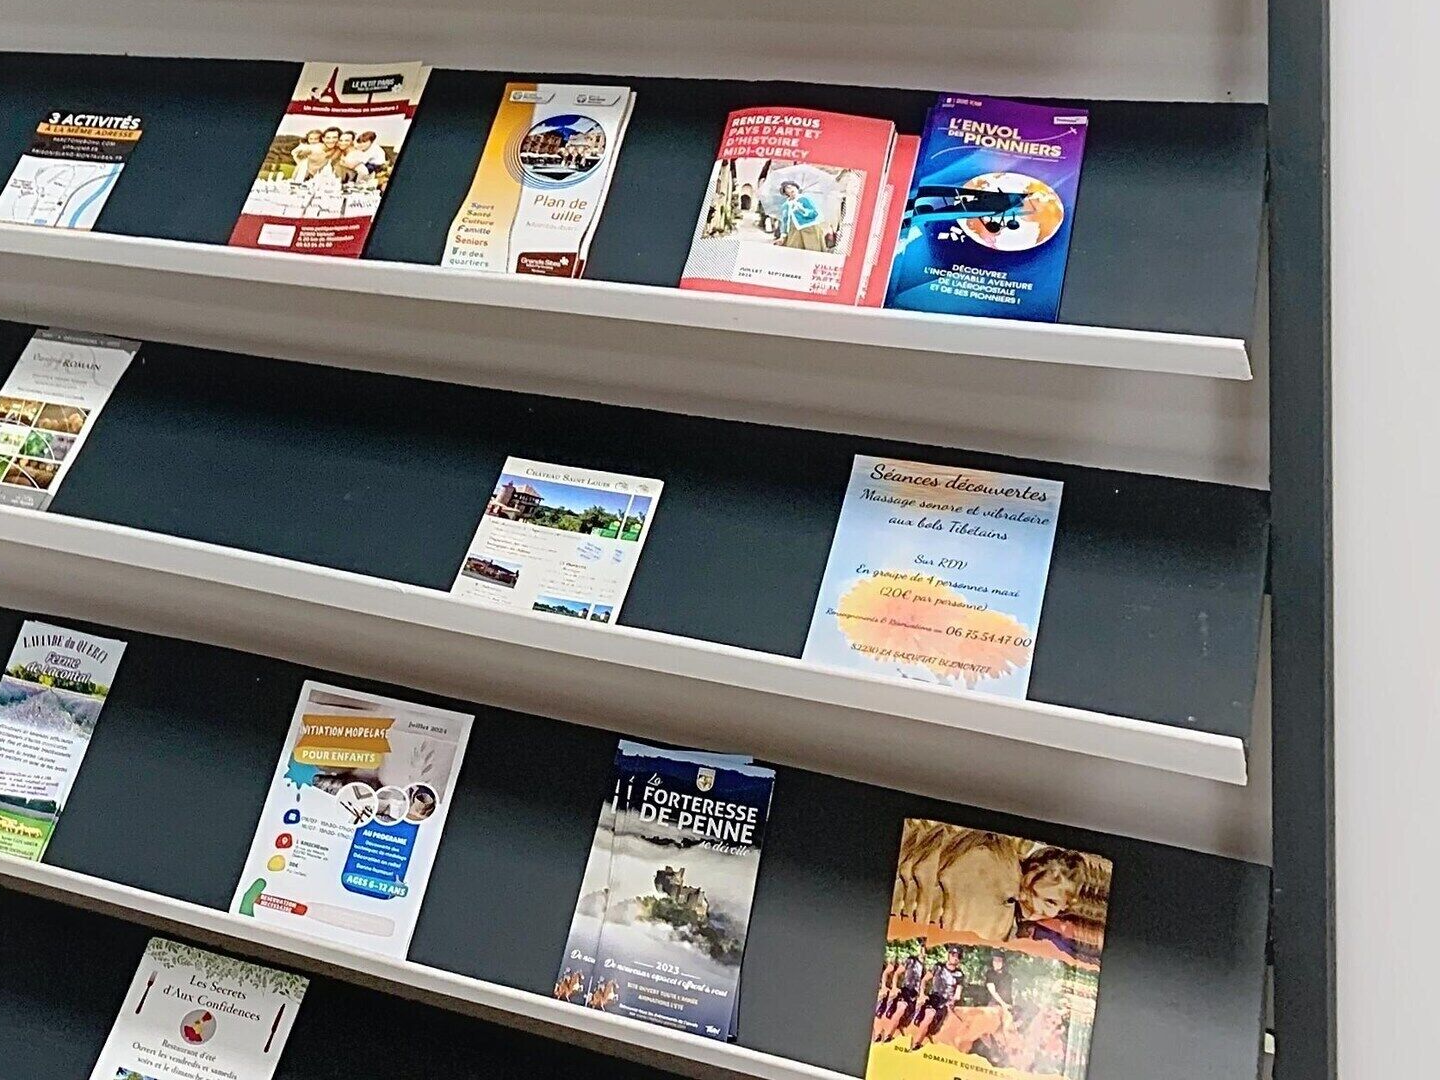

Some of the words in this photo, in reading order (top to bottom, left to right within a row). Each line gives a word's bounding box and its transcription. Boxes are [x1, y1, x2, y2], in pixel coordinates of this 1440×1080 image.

[351, 80, 359, 88] LE
[49, 112, 61, 124] 3
[63, 114, 141, 130] ACTIVITÉS
[732, 115, 821, 128] RENDEZ-VOUS
[94, 130, 134, 138] ADRESSE
[729, 126, 760, 136] PAYS
[763, 126, 801, 138] D'ART
[805, 130, 822, 139] ET
[949, 118, 1021, 140] L'ENVOL
[726, 135, 800, 147] D'HISTOIRE
[964, 132, 1063, 157] PIONNIERS
[723, 146, 810, 159] MIDI-QUERCY
[471, 202, 495, 210] Sport
[534, 195, 564, 208] Plan
[569, 195, 588, 210] de
[467, 209, 491, 218] Santé
[462, 217, 495, 226] Culture
[457, 225, 491, 235] Famille
[455, 235, 489, 247] Seniors
[469, 249, 484, 258] des
[449, 258, 489, 268] quartiers
[924, 266, 986, 284] L'INCROYABLE
[988, 278, 1033, 291] AVENTURE
[952, 264, 1008, 279] DÉCOUVREZ
[971, 291, 1016, 304] PIONNIERS
[870, 463, 940, 487] Séances
[945, 474, 1048, 502] découvertes
[859, 489, 916, 508] Massage
[919, 500, 962, 515] sonore
[966, 505, 980, 516] et
[983, 505, 1050, 526] vibratoire
[888, 516, 912, 527] aux
[917, 517, 943, 531] bols
[914, 554, 934, 566] Sur
[938, 557, 968, 570] RDV
[856, 563, 870, 575] En
[873, 569, 907, 583] groupe
[909, 570, 924, 582] de
[935, 577, 988, 594] personnes
[991, 587, 1020, 599] maxi
[912, 592, 931, 604] par
[934, 595, 988, 612] personne)
[45, 651, 81, 668] Ferme
[302, 750, 329, 762] POUR
[331, 751, 375, 762] ENFANTS
[643, 786, 759, 823] FORTERESSE
[639, 803, 672, 827] DE
[678, 810, 755, 844] PENNE
[711, 840, 751, 856] dévoile
[346, 875, 366, 888] AGES
[387, 884, 407, 896] ANS
[656, 961, 680, 974] 2023
[190, 975, 207, 989] Les
[210, 982, 247, 1000] Secrets
[163, 985, 194, 1003] d'Aux
[197, 995, 261, 1021] Confidences
[162, 1039, 199, 1055] Restaurant
[199, 1049, 216, 1062] d'été
[132, 1042, 156, 1056] Ouvert
[169, 1054, 201, 1069] vendredis
[210, 1068, 238, 1080] samedis
[137, 1056, 152, 1066] soirs
[923, 1054, 958, 1067] DOMAINE
